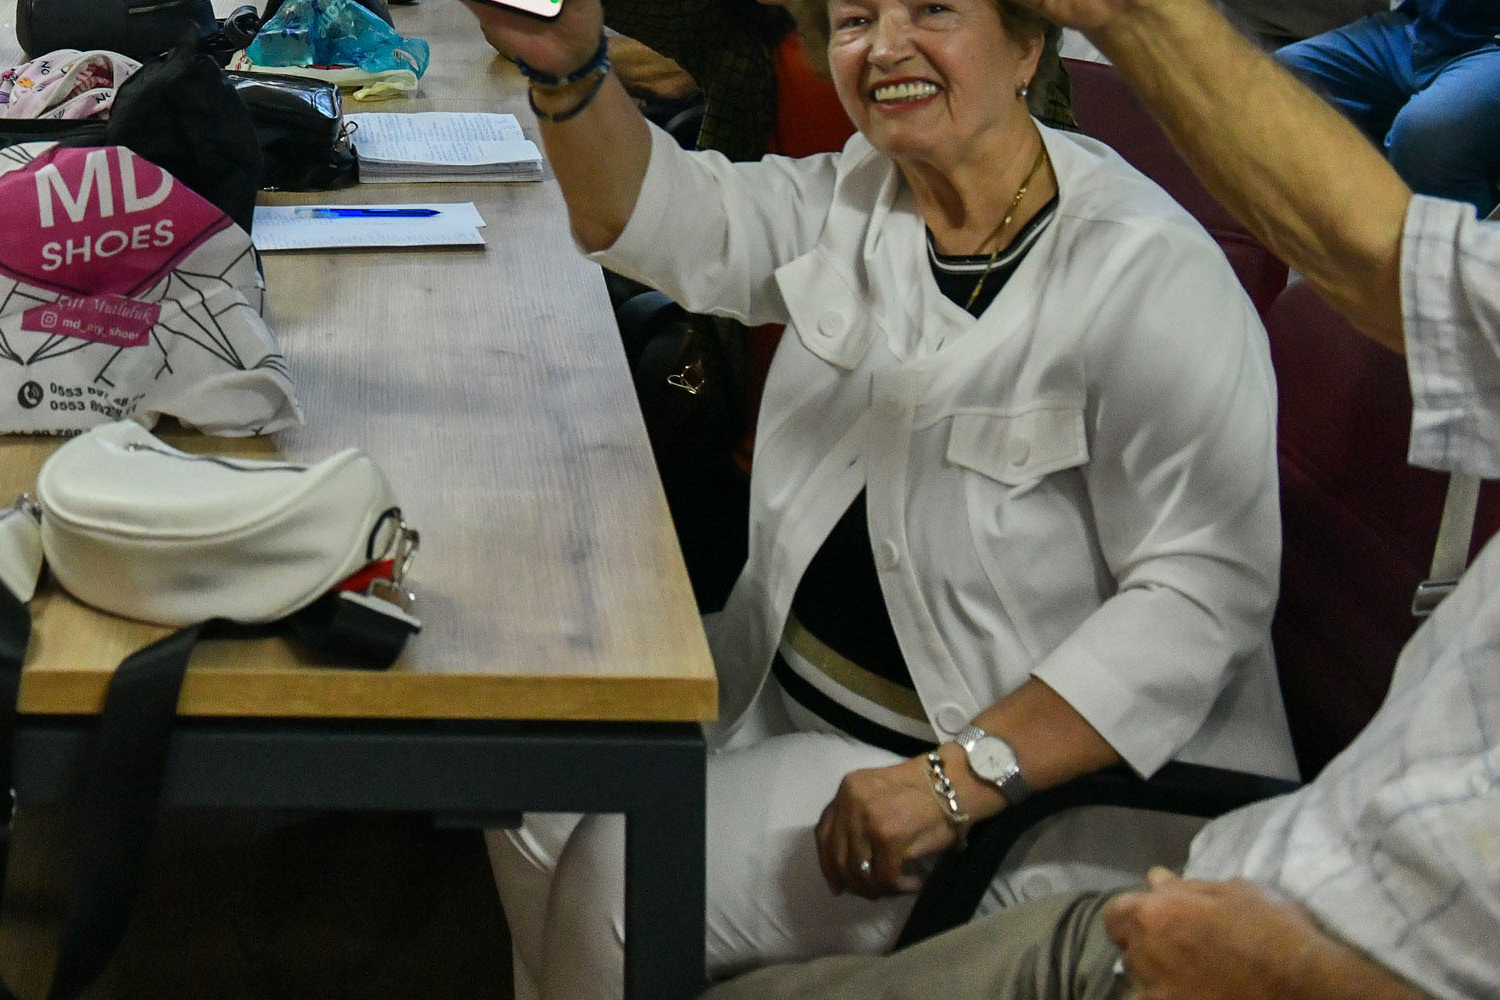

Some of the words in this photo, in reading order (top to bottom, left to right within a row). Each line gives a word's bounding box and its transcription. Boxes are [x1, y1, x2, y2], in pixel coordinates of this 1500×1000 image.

[34, 145, 174, 228] MD
[41, 219, 175, 271] SHOES
[50, 382, 83, 398] 0553
[50, 400, 86, 411] 0553
